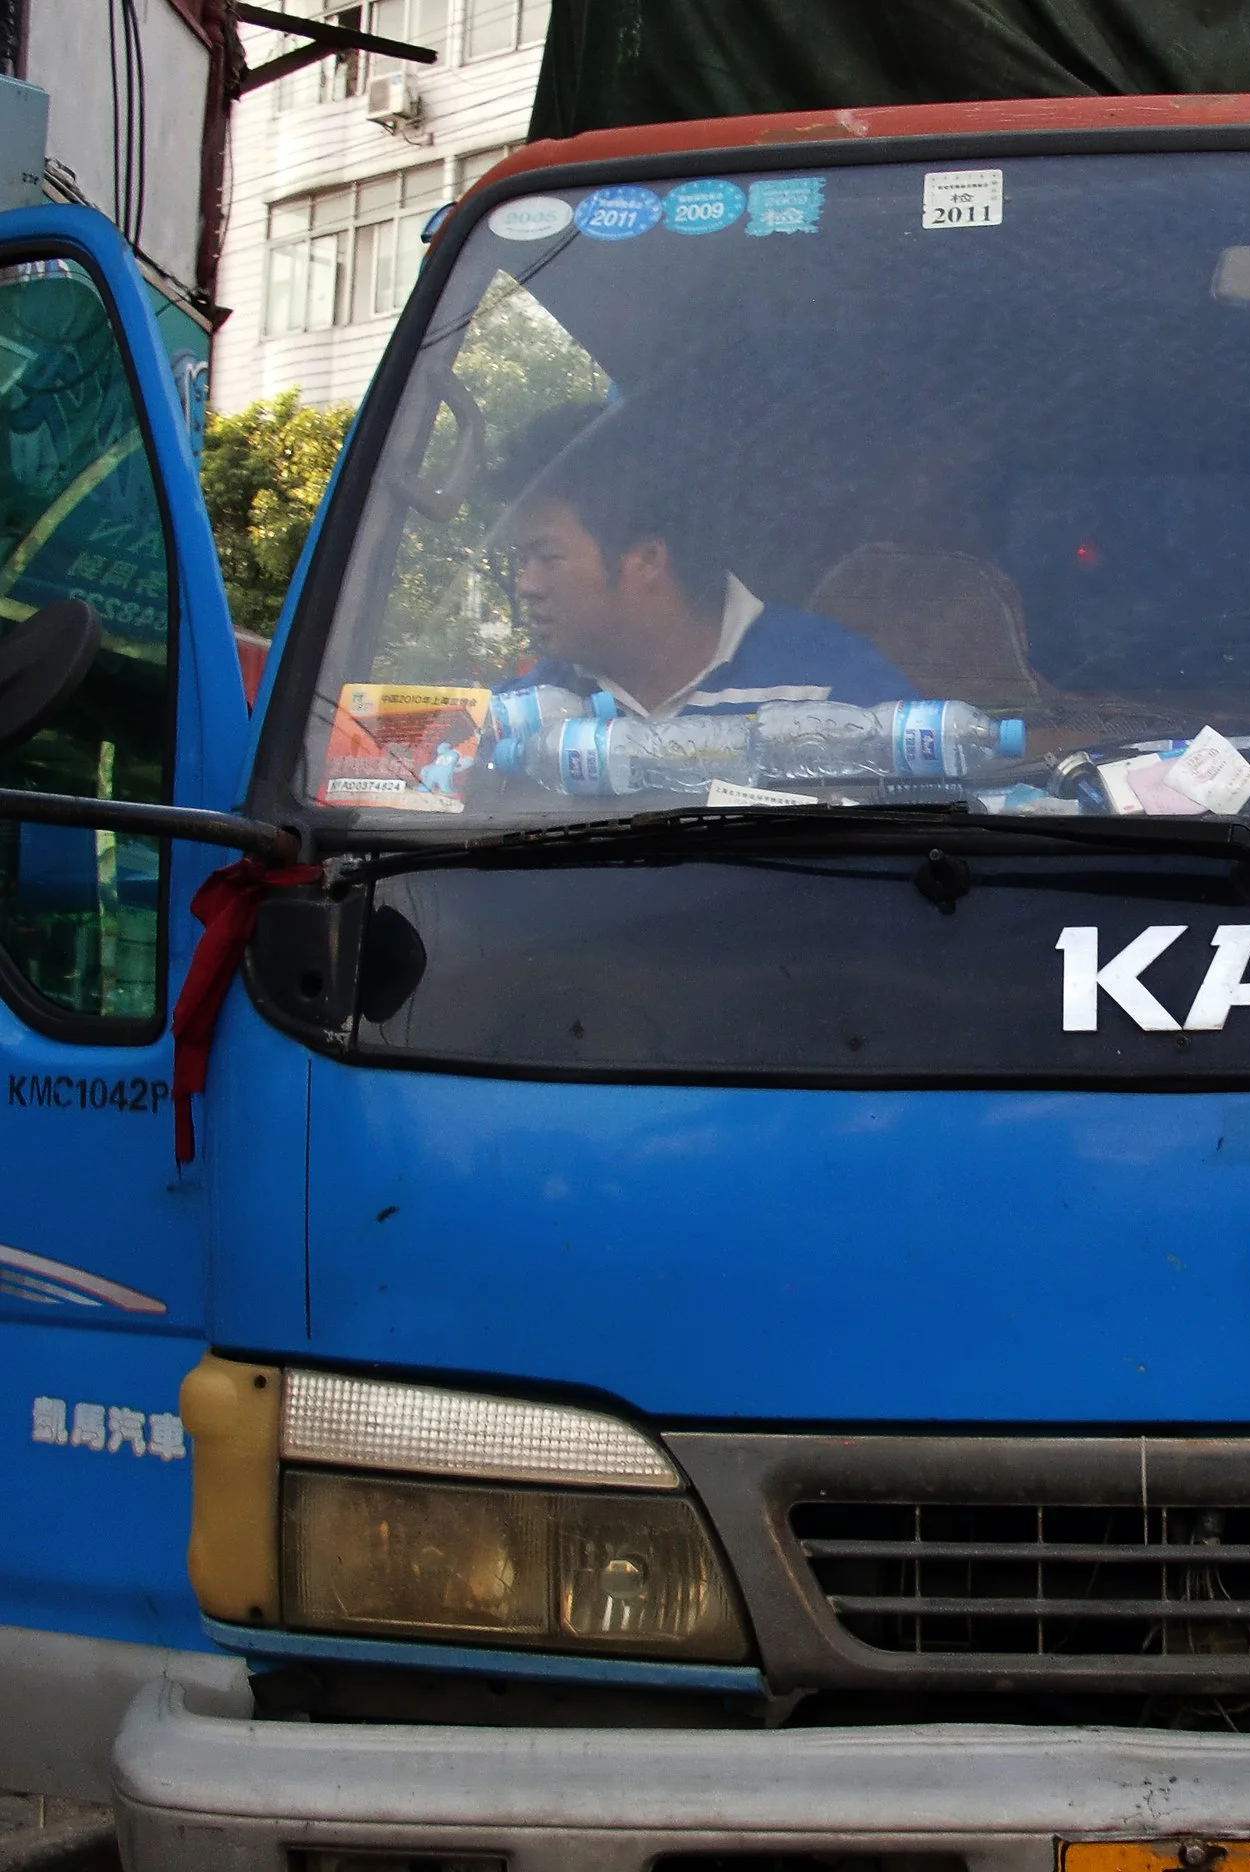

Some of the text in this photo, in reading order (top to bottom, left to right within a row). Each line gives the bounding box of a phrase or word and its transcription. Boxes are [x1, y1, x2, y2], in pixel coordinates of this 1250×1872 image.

[589, 209, 637, 227] 2011
[674, 202, 725, 222] 2009
[931, 205, 991, 225] 2011
[8, 1073, 169, 1114] KMC1042P
